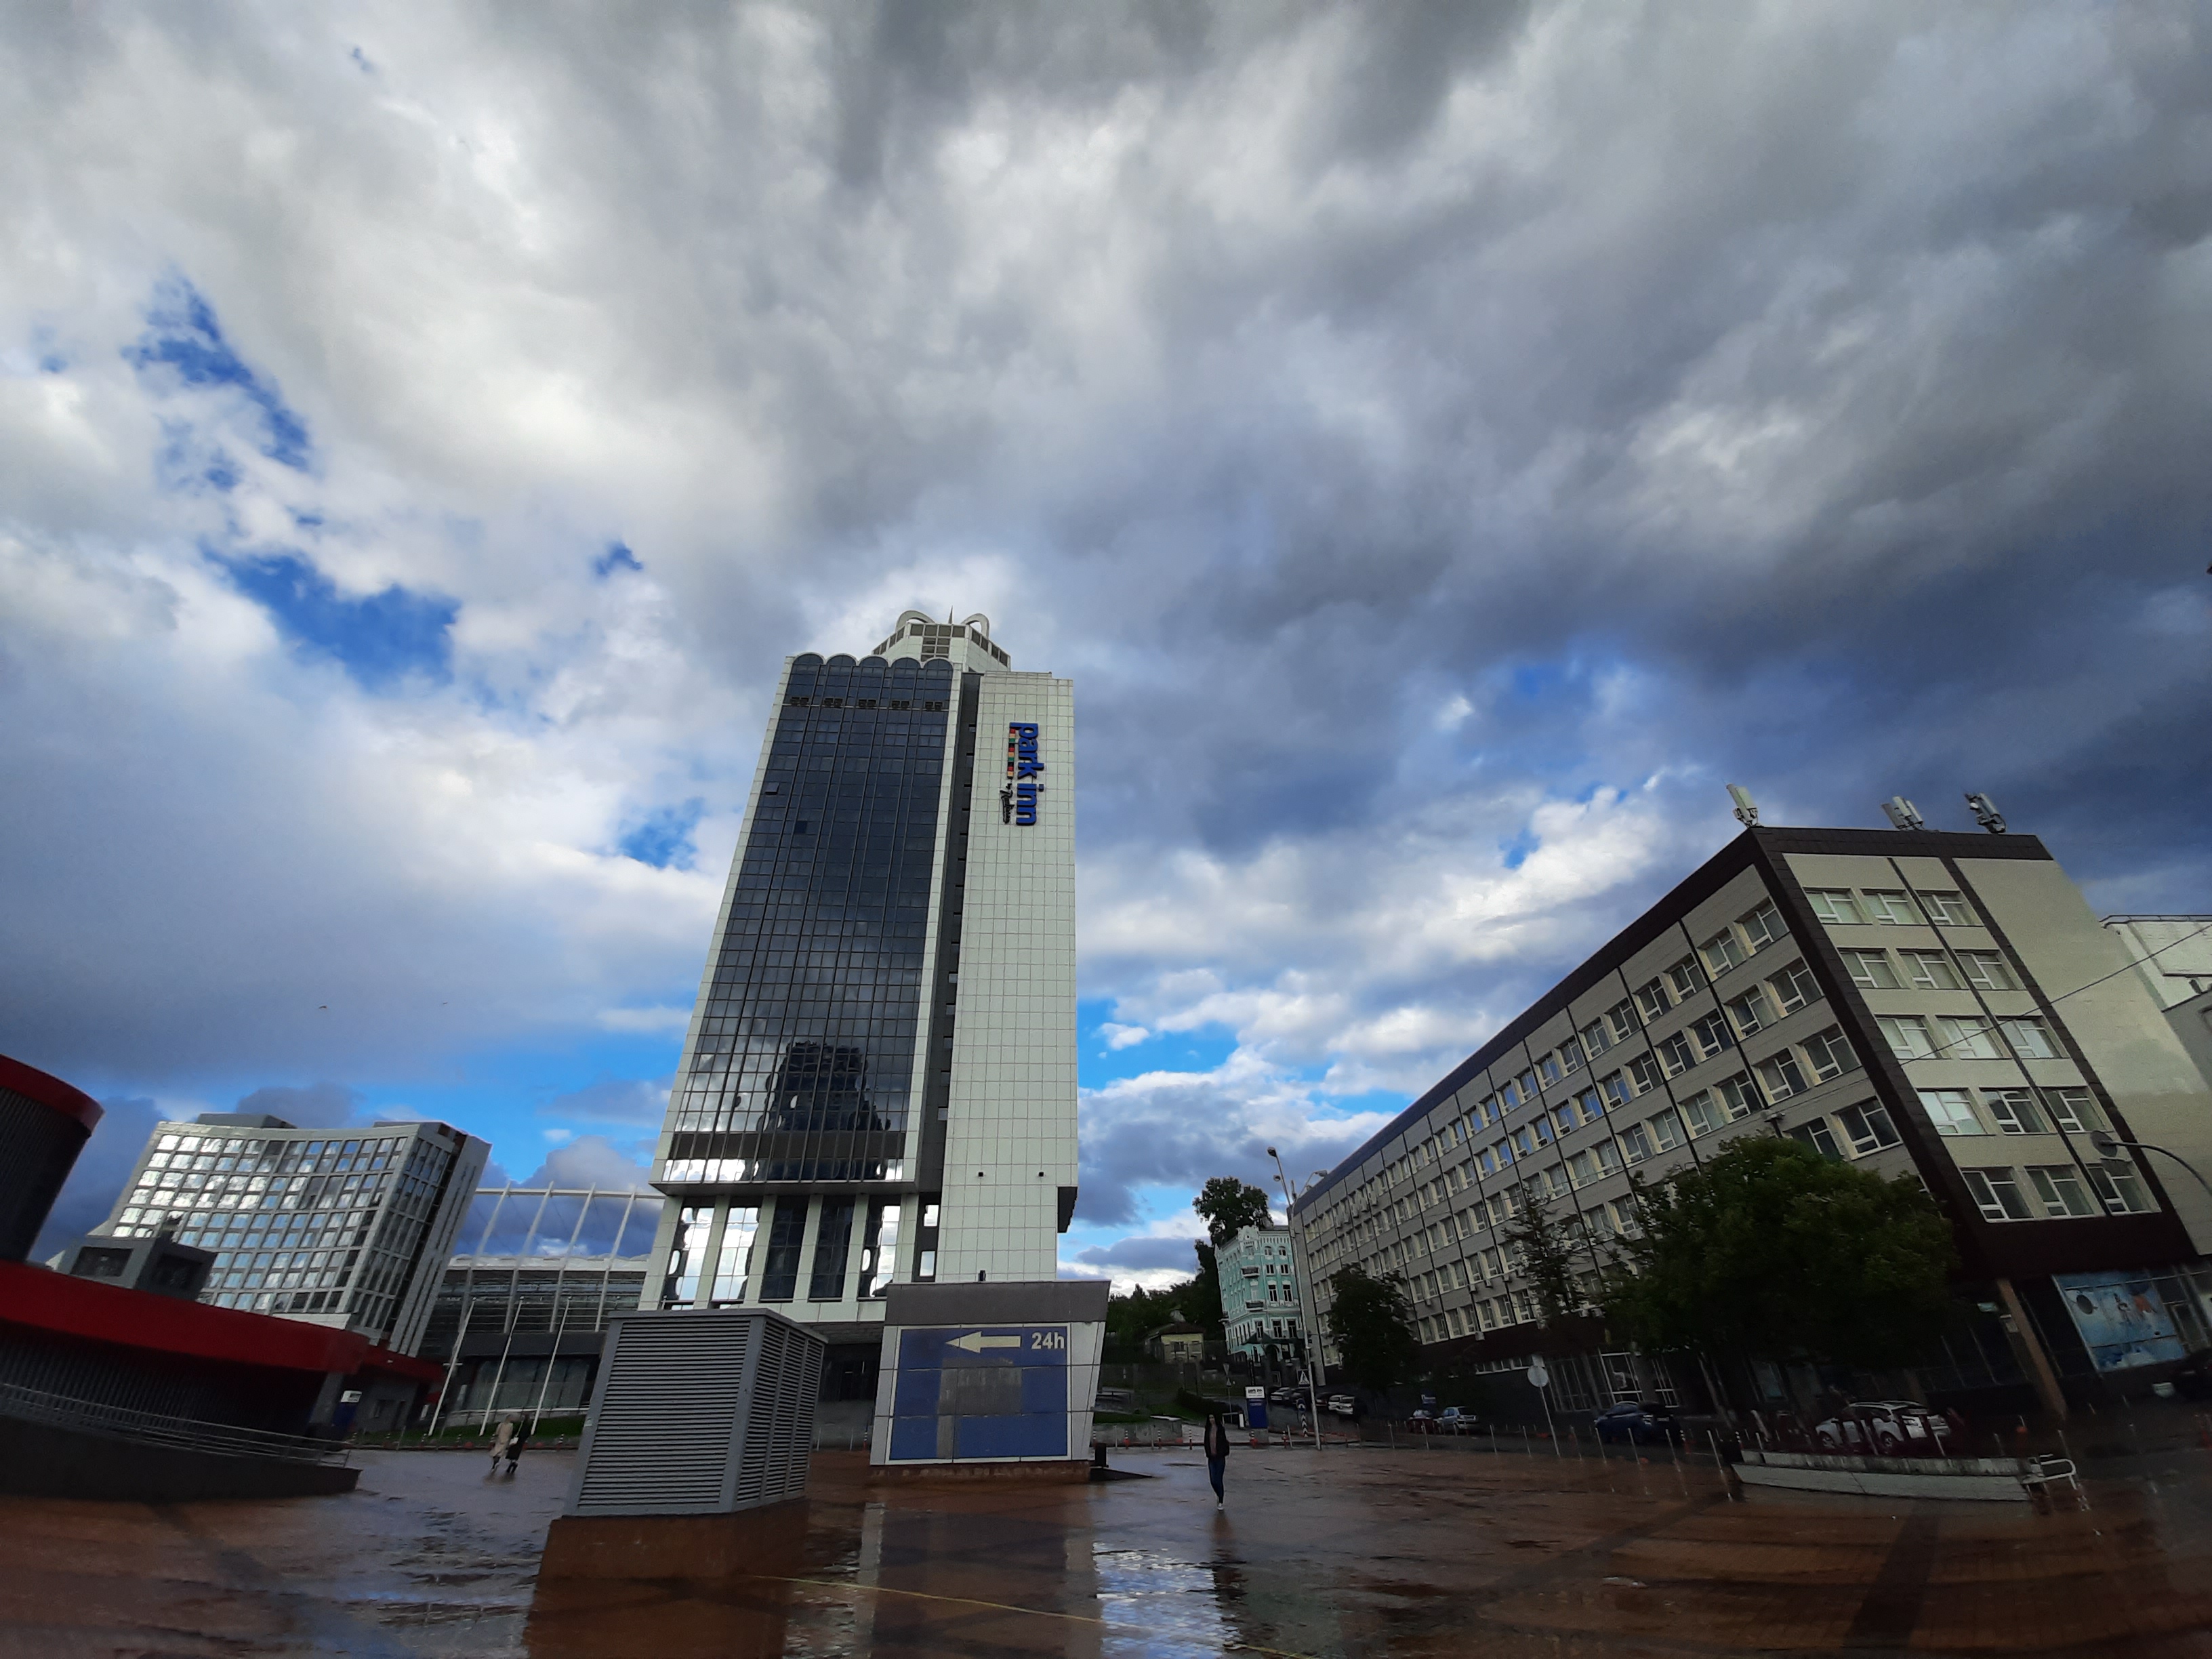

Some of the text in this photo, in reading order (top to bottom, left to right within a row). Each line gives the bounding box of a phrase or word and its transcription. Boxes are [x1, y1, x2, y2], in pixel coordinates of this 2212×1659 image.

[1009, 722, 1044, 825] park inn
[1031, 1332, 1065, 1349] 24h
